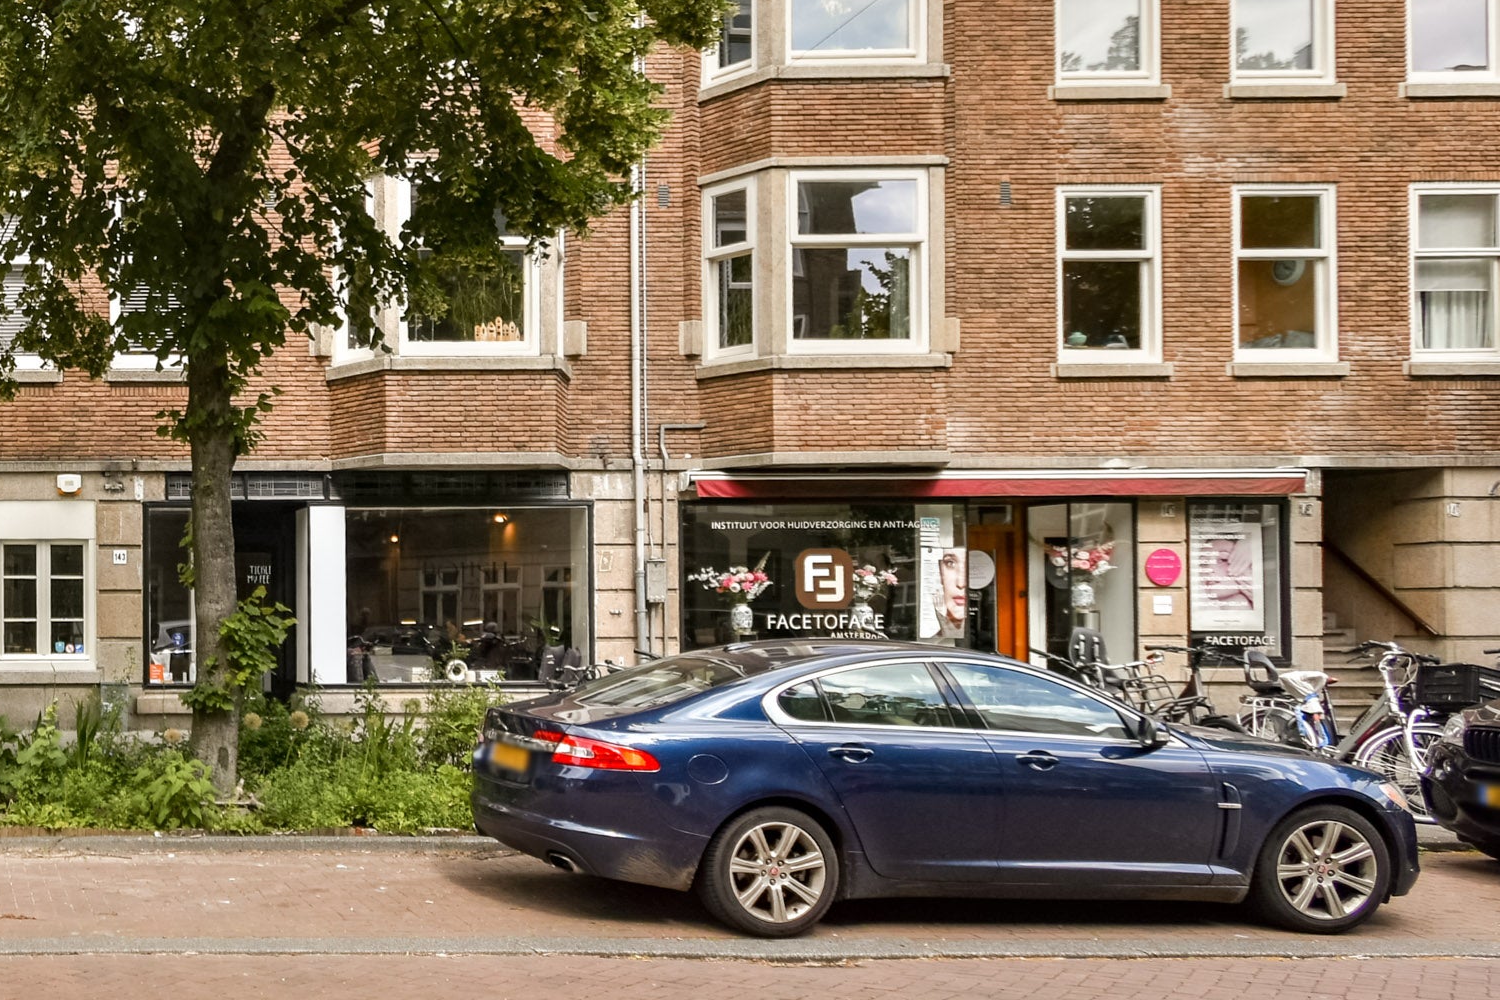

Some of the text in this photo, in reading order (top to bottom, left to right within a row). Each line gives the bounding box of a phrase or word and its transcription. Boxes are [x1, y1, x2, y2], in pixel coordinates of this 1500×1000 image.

[711, 520, 939, 530] INSTITUUT VOOR HUIDVERZORGING EN ANTI-AGING
[114, 553, 126, 561] 143
[767, 614, 885, 630] FACETOFACE
[1207, 636, 1276, 646] FACETOFACE
